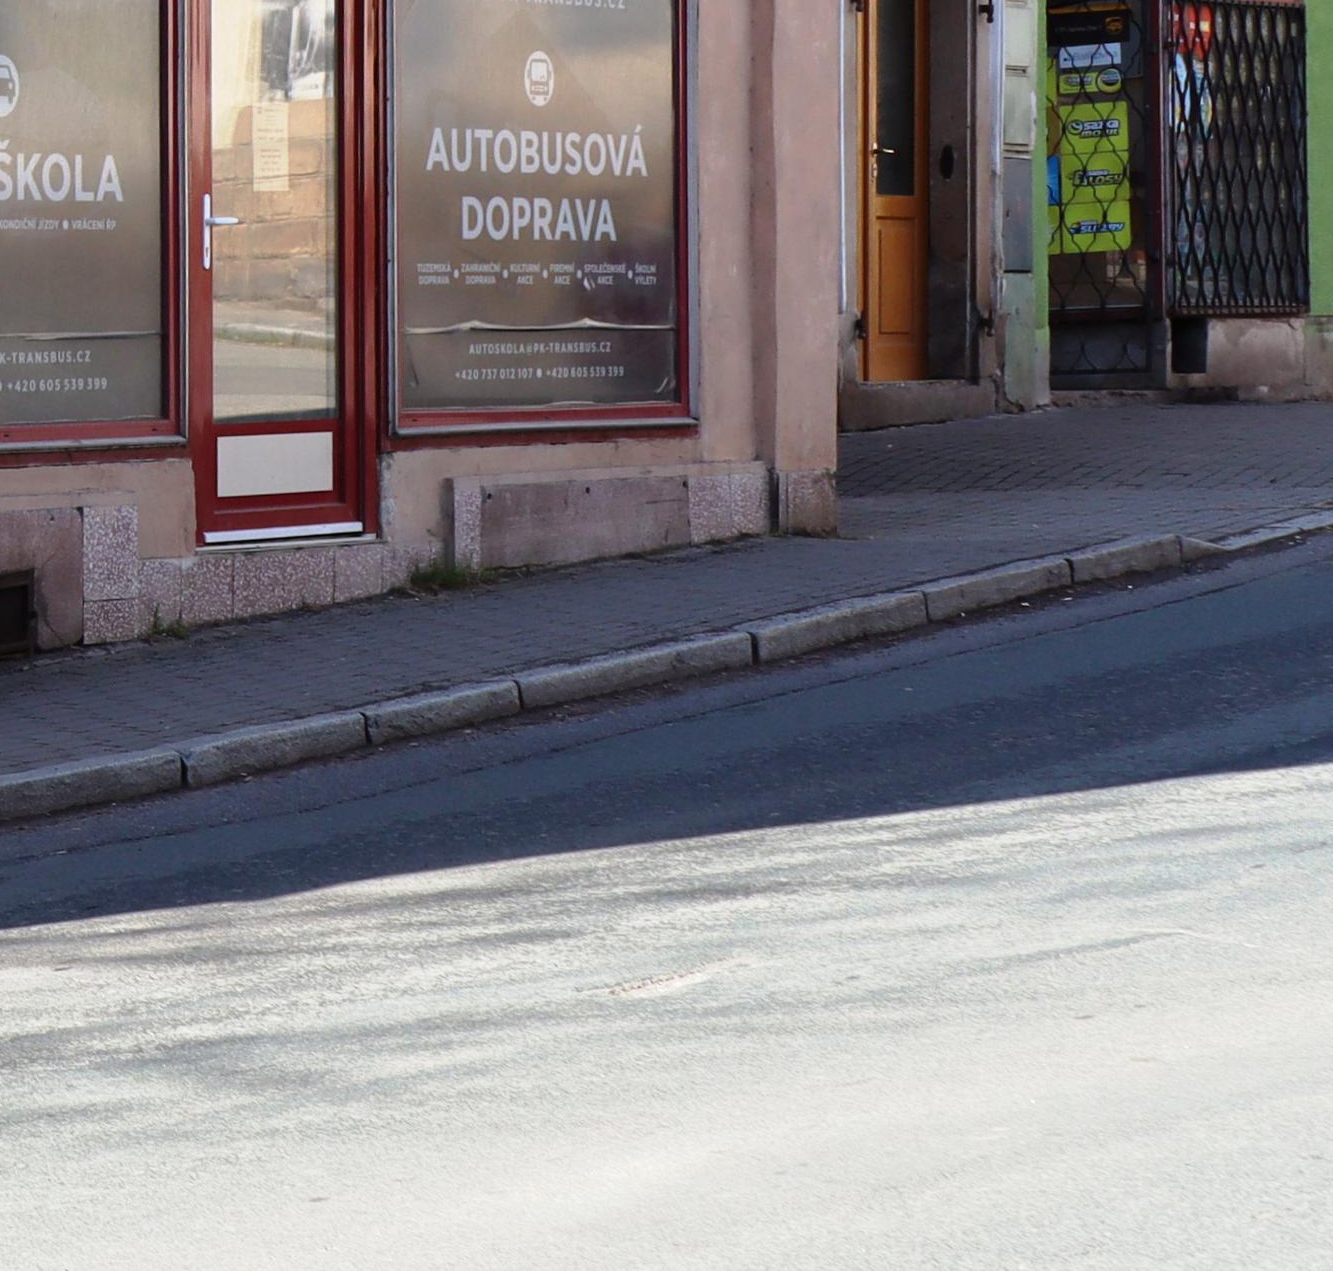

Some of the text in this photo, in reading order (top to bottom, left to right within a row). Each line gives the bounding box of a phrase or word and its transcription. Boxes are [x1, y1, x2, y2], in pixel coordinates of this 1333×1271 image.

[426, 124, 648, 177] AUTOBUSOVÁ
[461, 196, 617, 242] DOPRAVA
[7, 379, 37, 392] +420
[39, 379, 60, 392] 605
[63, 378, 84, 391] 539
[86, 377, 108, 390] 399
[455, 368, 479, 380] +420
[499, 368, 515, 380] 012
[517, 368, 533, 379] 107
[546, 367, 568, 378] +420
[570, 366, 588, 378] 605
